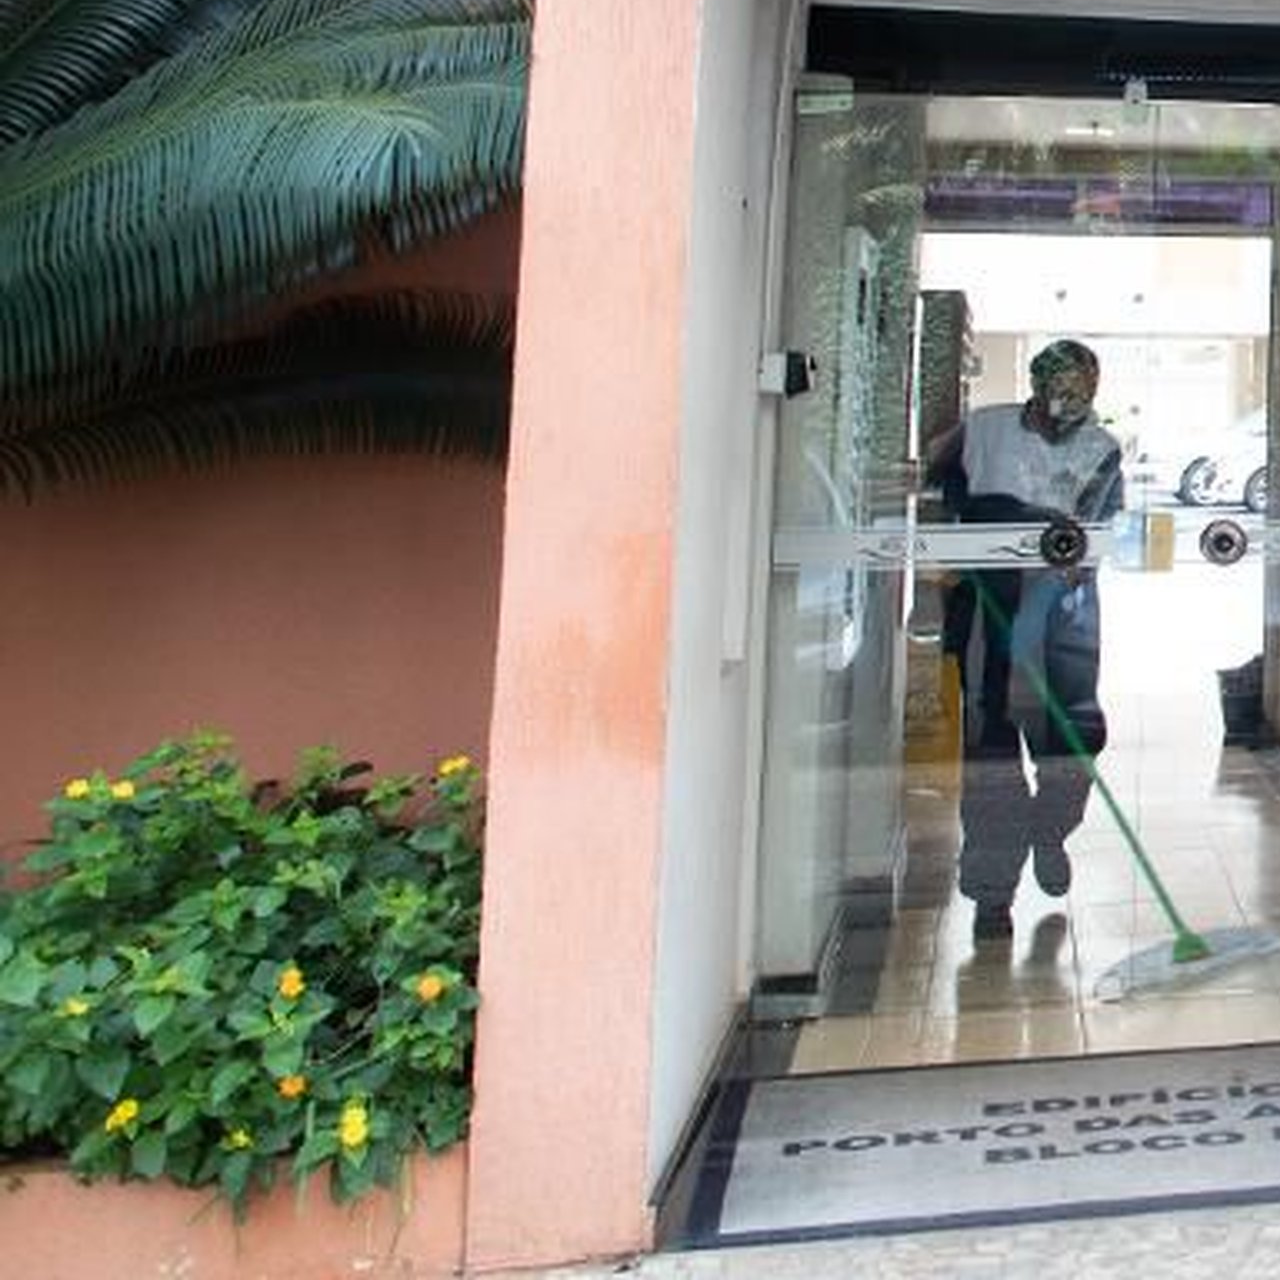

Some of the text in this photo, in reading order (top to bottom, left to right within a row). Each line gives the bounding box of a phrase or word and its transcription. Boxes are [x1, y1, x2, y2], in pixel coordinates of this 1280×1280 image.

[782, 1122, 1046, 1156] PORTO
[1074, 1110, 1216, 1132] DAS
[984, 1131, 1245, 1163] BLOCO
